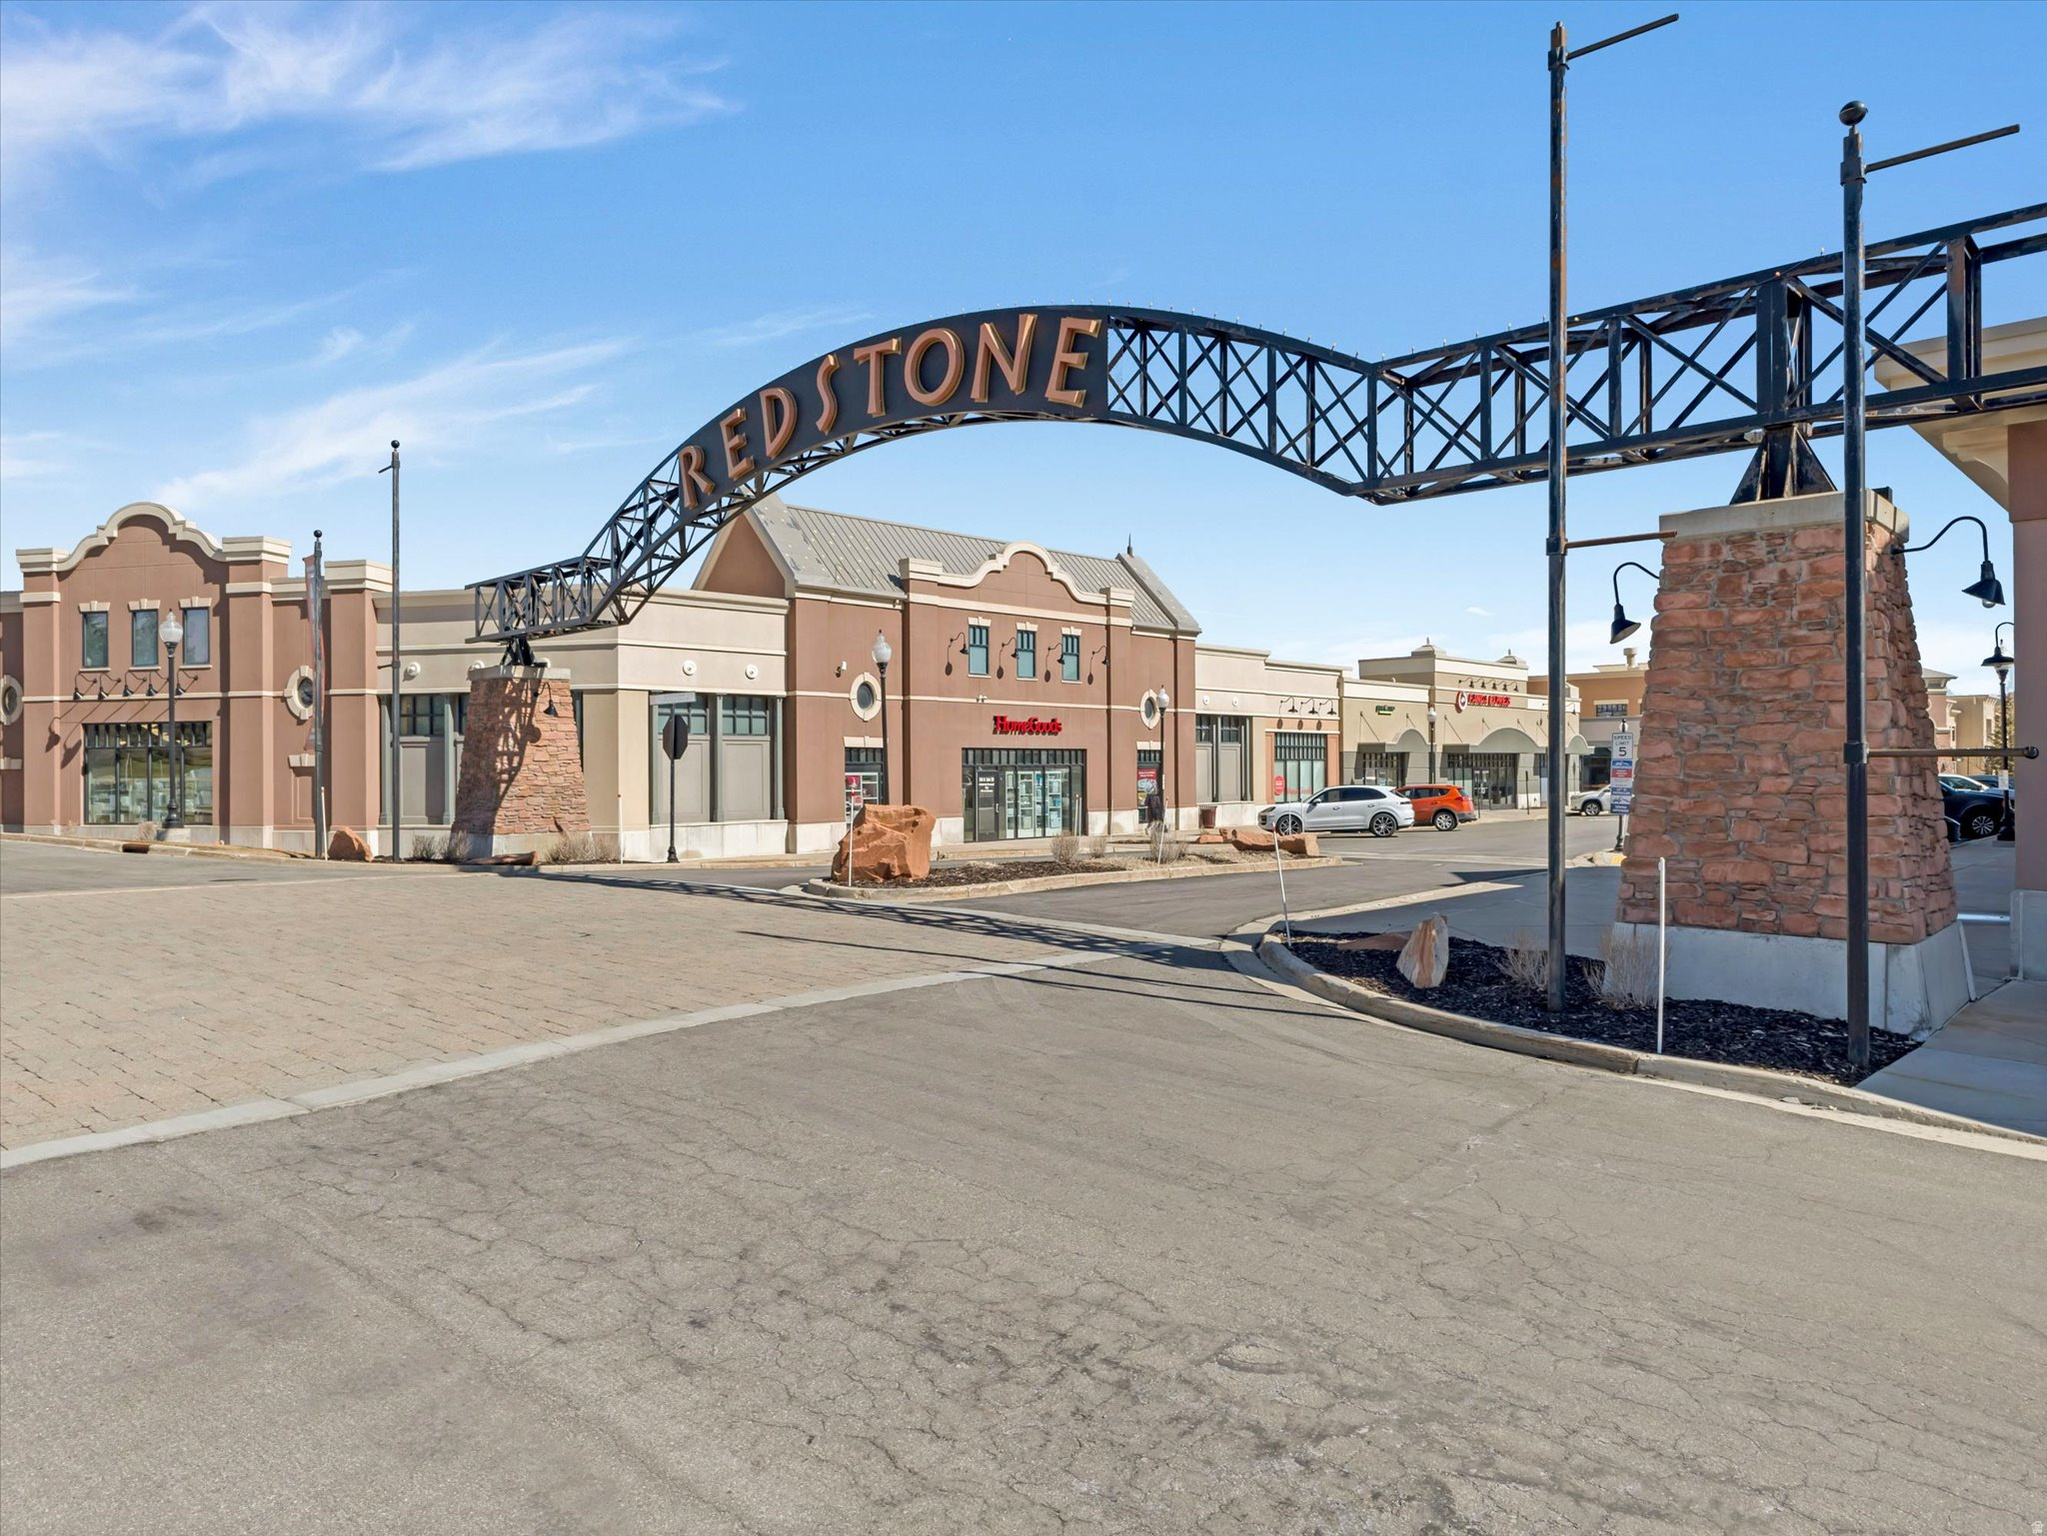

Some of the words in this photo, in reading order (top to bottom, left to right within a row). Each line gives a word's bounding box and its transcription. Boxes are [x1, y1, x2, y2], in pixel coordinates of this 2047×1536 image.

[678, 313, 1102, 510] REDSTONE
[993, 714, 1063, 734] HomeGoods
[1618, 746, 1627, 757] 5
